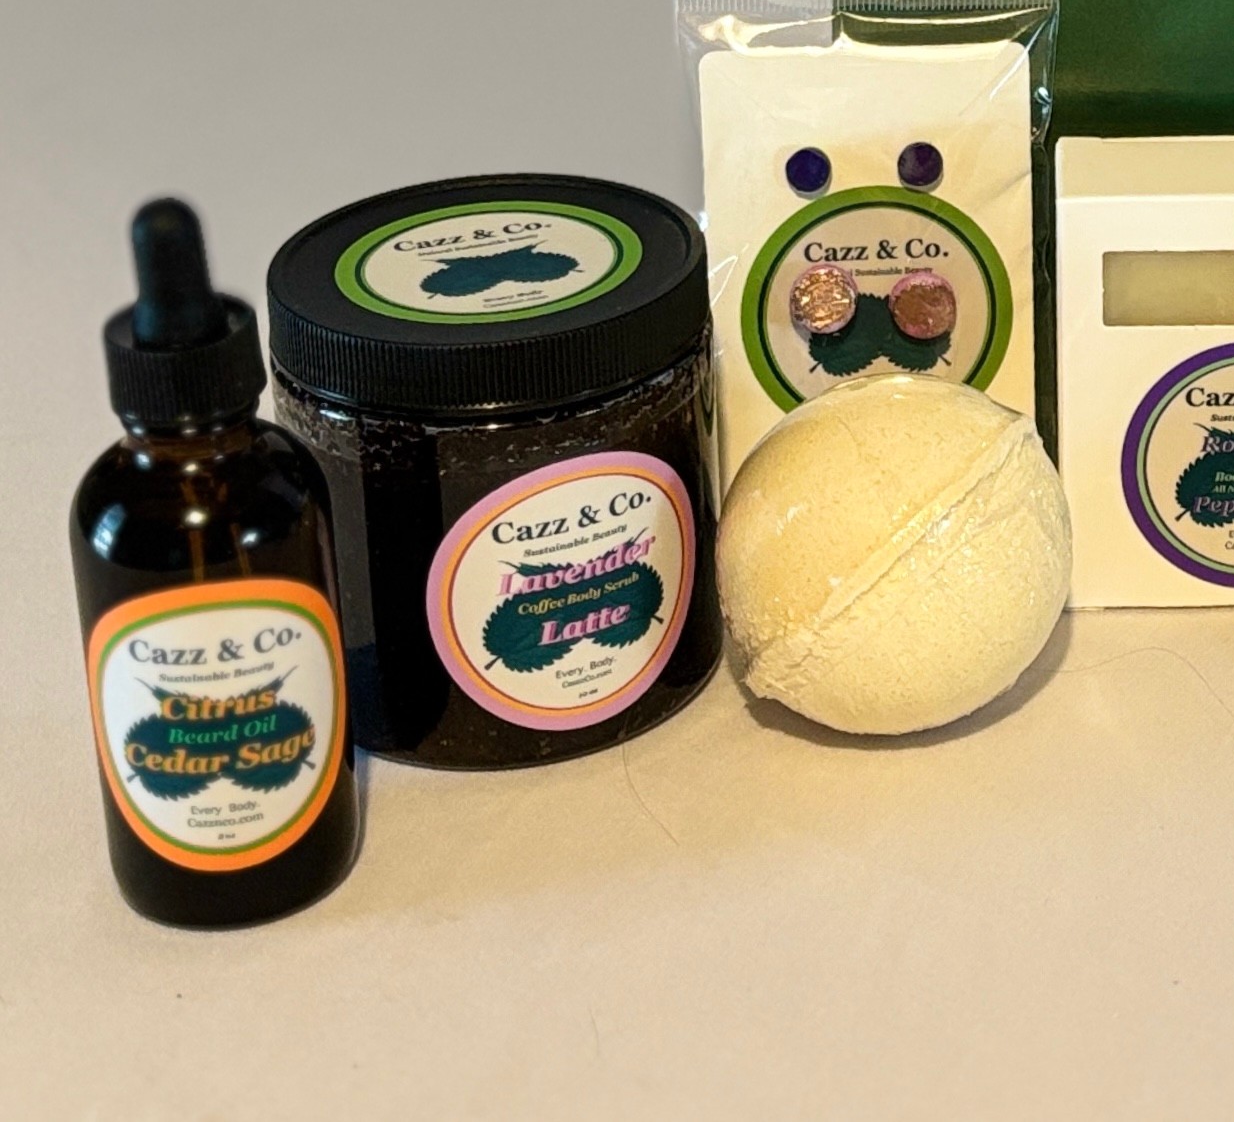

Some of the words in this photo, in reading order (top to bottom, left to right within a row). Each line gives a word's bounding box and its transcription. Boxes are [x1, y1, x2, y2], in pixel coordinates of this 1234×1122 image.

[394, 235, 465, 251] Cazz
[473, 230, 495, 240] &
[503, 221, 552, 234] Co.
[804, 242, 869, 262] Cazz
[876, 240, 898, 260] &
[906, 238, 949, 258] Co.
[492, 517, 569, 545] Cazz
[578, 505, 601, 528] &
[609, 491, 651, 517] Co.
[524, 537, 589, 558] Sustainable
[592, 524, 627, 542] Beauty
[497, 536, 655, 596] Lavender
[518, 599, 564, 615] Coffee
[568, 588, 602, 604] Body
[604, 573, 639, 594] Scrub
[538, 604, 630, 646] Latte
[129, 640, 207, 666] Cazz
[217, 639, 244, 662] &
[254, 627, 302, 653] Co.
[159, 671, 230, 684] Sustainable
[234, 662, 274, 678] Beauty
[161, 690, 276, 720] Citrus
[169, 724, 238, 744] Beard
[244, 716, 276, 737] Oil
[126, 743, 230, 774] Cedar
[236, 729, 316, 769] Sage
[191, 806, 221, 816] Every
